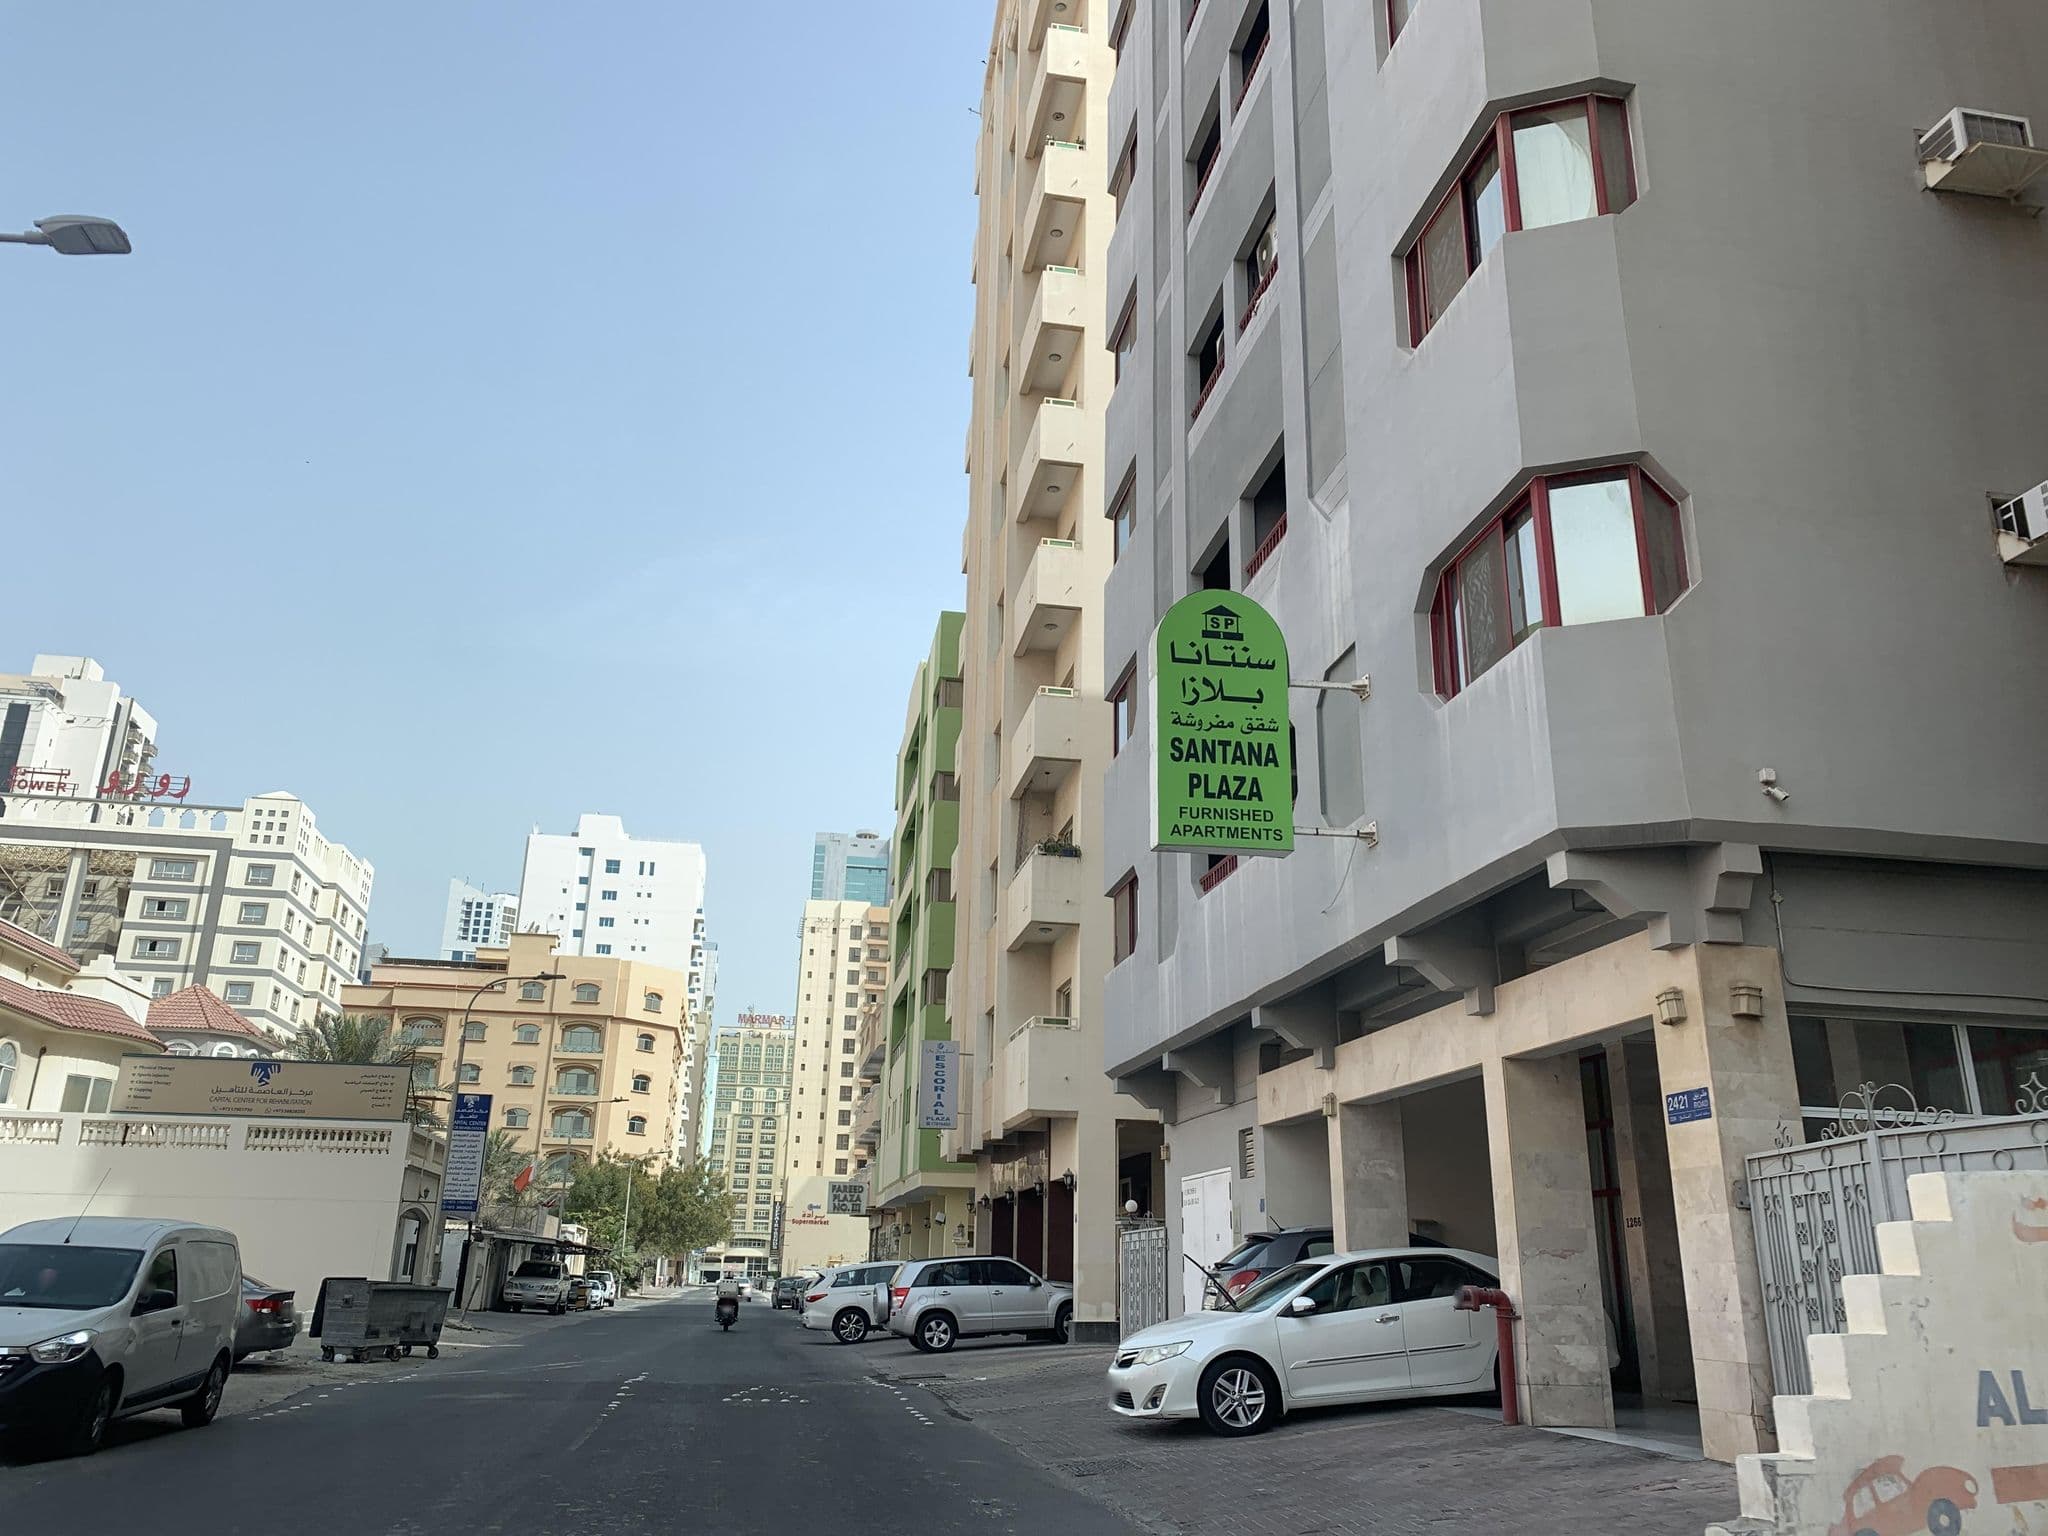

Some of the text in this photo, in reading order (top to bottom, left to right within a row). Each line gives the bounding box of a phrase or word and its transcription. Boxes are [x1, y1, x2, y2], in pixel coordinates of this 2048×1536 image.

[1170, 639, 1276, 671] سنتانا
[1181, 677, 1264, 710] بلازا
[1171, 711, 1280, 735] شقق مفروشة
[1170, 737, 1279, 767] SANTANA
[1188, 773, 1263, 802] PLAZA
[1178, 806, 1274, 823] FURNISHED
[1170, 824, 1283, 842] APARTMENTS
[933, 1055, 946, 1116] ESCORIAL
[268, 1098, 312, 1106] REHABILITATION
[1668, 1094, 1689, 1111] 2421
[832, 1184, 864, 1194] FAREED
[832, 1194, 862, 1203] PLAZA
[832, 1203, 850, 1213] NO.
[792, 1218, 829, 1226] Supermarket
[1976, 1370, 2048, 1427] AL
